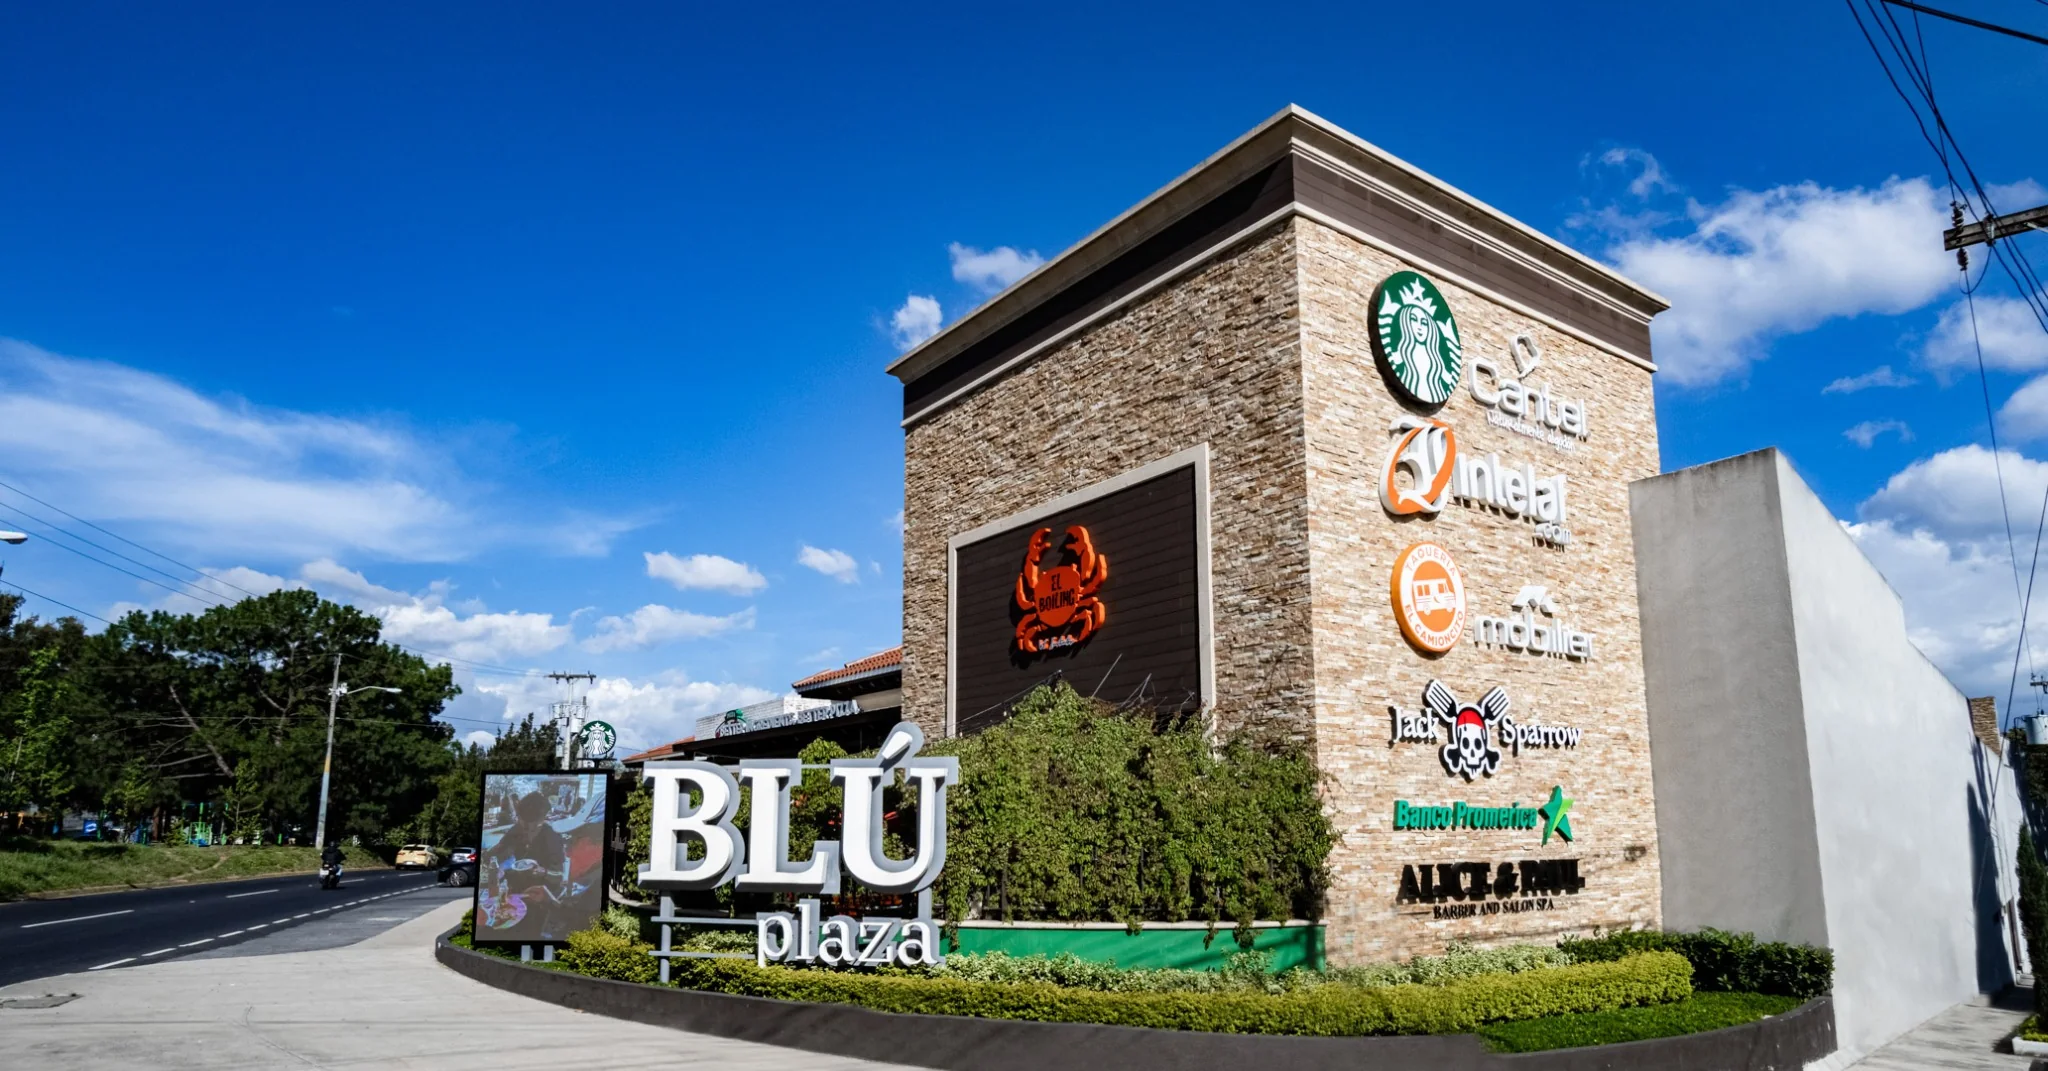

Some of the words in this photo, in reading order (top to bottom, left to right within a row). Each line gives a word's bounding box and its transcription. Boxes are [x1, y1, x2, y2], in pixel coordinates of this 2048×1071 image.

[1038, 588, 1075, 612] BOILING
[1051, 573, 1062, 592] EL
[1404, 604, 1414, 623] EL
[1414, 610, 1464, 647] CAMIONCITO
[1475, 608, 1596, 658] mobilier
[1391, 704, 1440, 744] Jack
[1501, 714, 1582, 751] Sparrow
[638, 724, 958, 893] BLÚ
[1394, 800, 1452, 830] Banco
[1453, 801, 1538, 830] Promerica
[1493, 861, 1519, 901] &
[1433, 904, 1476, 920] BARBER
[1479, 901, 1500, 916] AND
[1502, 900, 1535, 915] SALON
[1536, 898, 1554, 911] SPA
[757, 900, 940, 968] plaza
